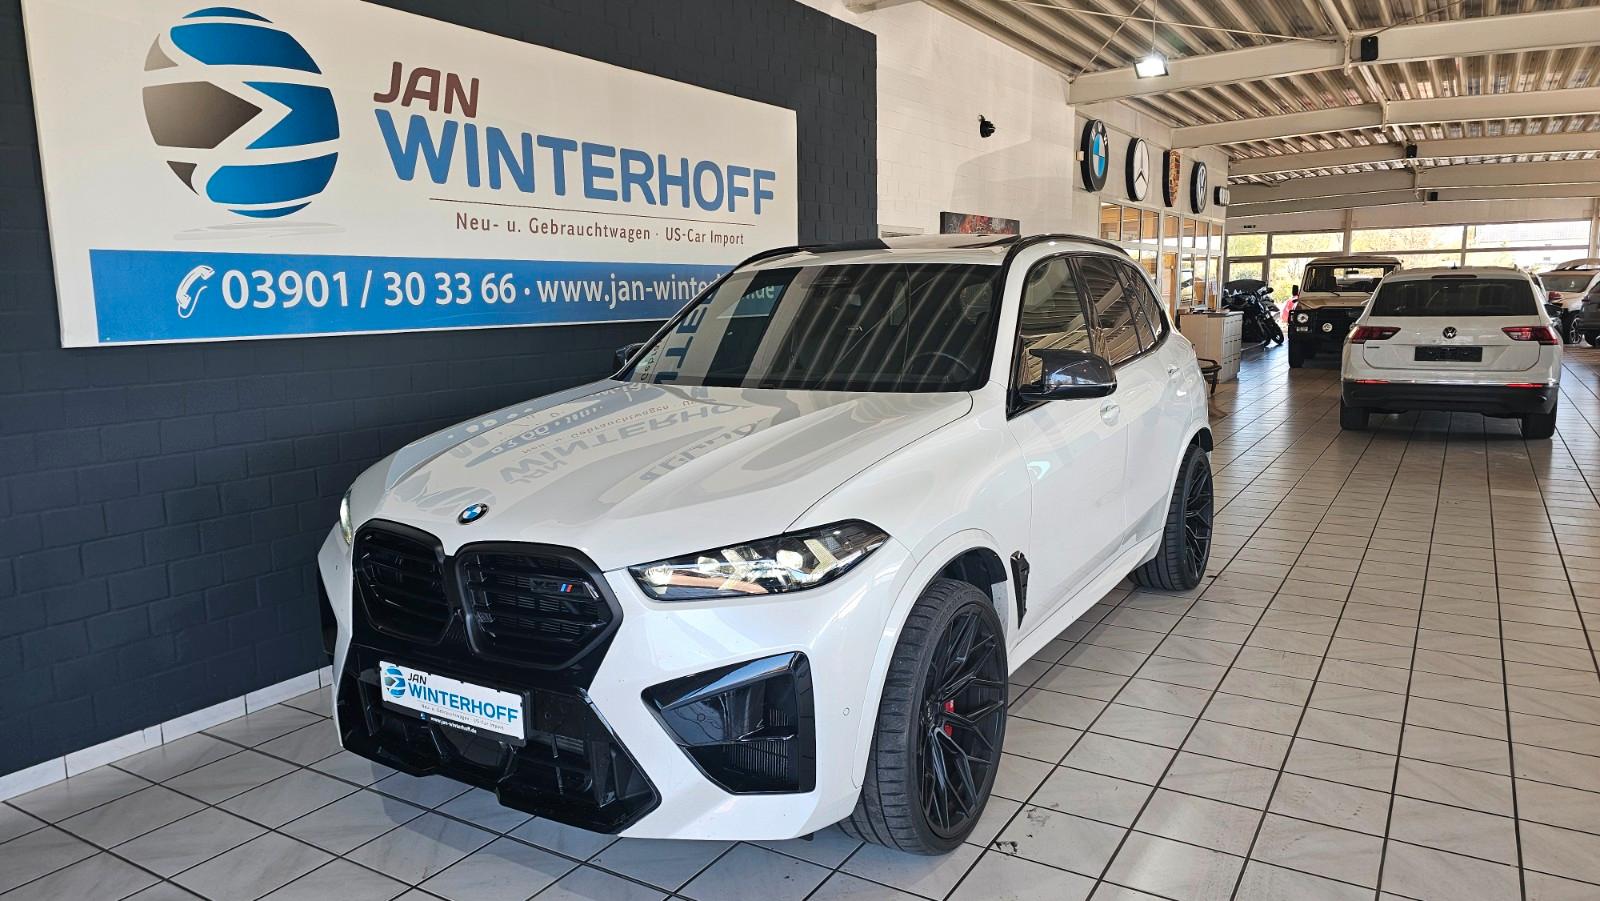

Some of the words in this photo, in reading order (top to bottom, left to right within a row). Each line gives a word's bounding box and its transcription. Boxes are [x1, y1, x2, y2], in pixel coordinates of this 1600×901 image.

[373, 61, 480, 118] JAN
[374, 108, 776, 215] WINTERHOFF
[456, 212, 499, 231] Neu-
[507, 220, 521, 233] u.
[529, 217, 650, 244] Gebrauchtwagen
[665, 226, 705, 243] US-Car
[710, 230, 744, 247] Import
[221, 269, 348, 310] 03901
[383, 271, 426, 306] 30
[434, 272, 472, 305] 33
[480, 272, 517, 304] 66
[407, 672, 427, 685] JAN
[408, 682, 519, 723] WINTERHOFF
